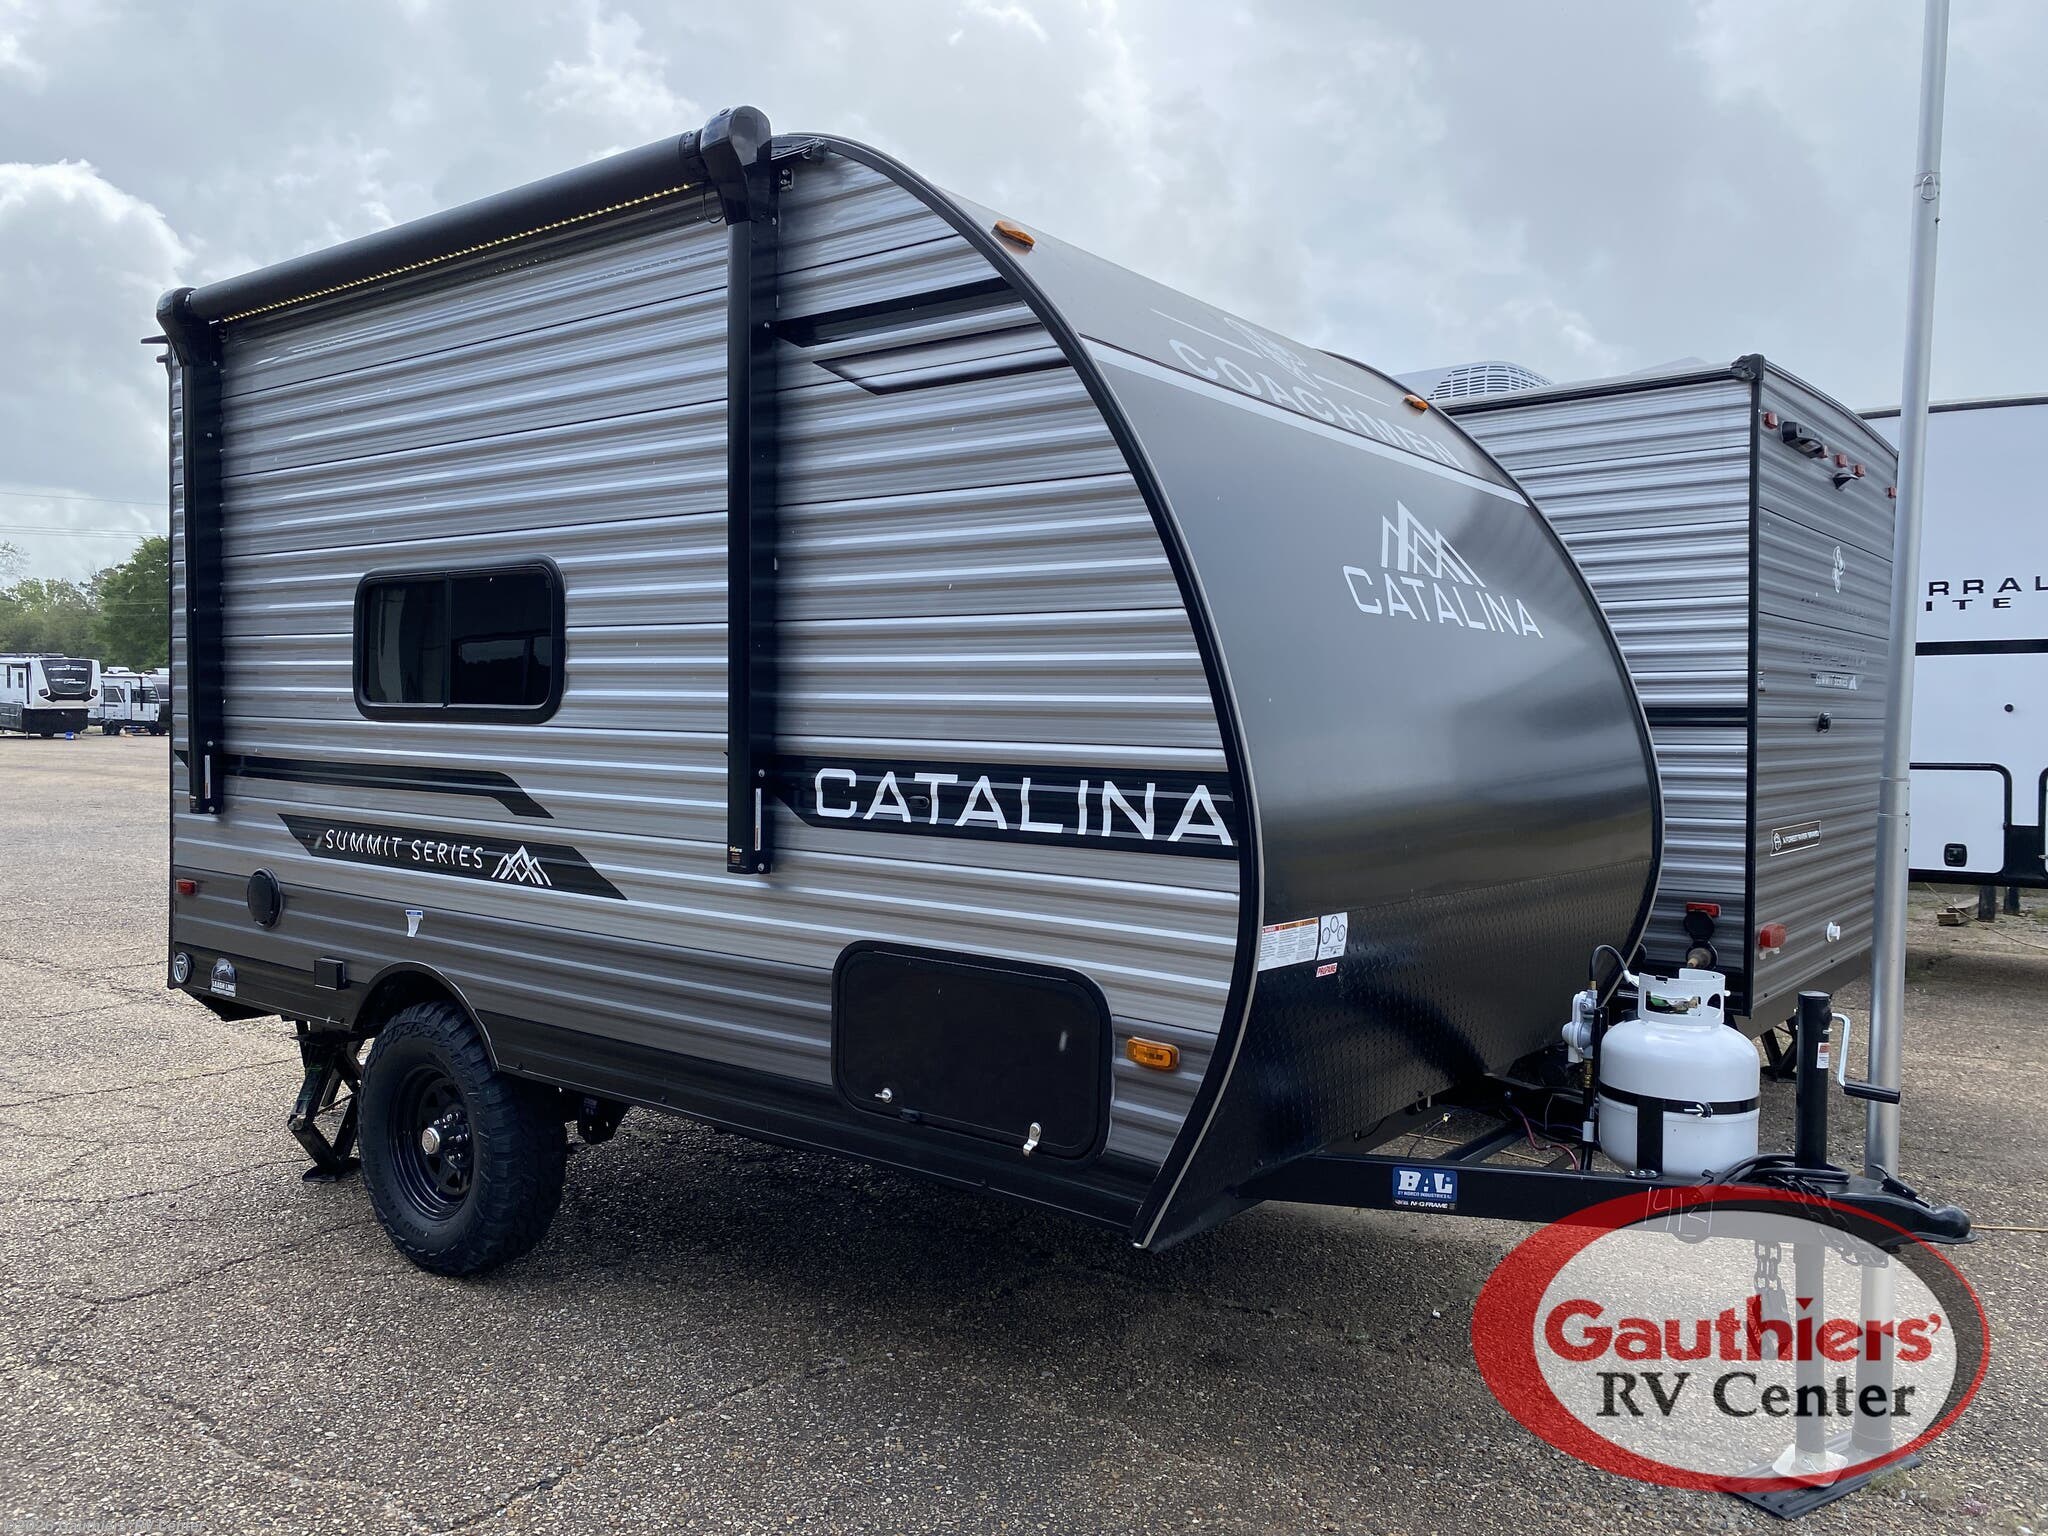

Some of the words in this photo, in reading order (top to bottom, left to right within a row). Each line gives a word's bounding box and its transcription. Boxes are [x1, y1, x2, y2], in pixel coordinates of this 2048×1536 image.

[1169, 338, 1464, 468] COACHMEN
[1342, 566, 1544, 638] CATALINA
[814, 767, 1234, 846] CATALINA
[325, 829, 403, 858] SUMMIT
[410, 839, 484, 869] SERIES
